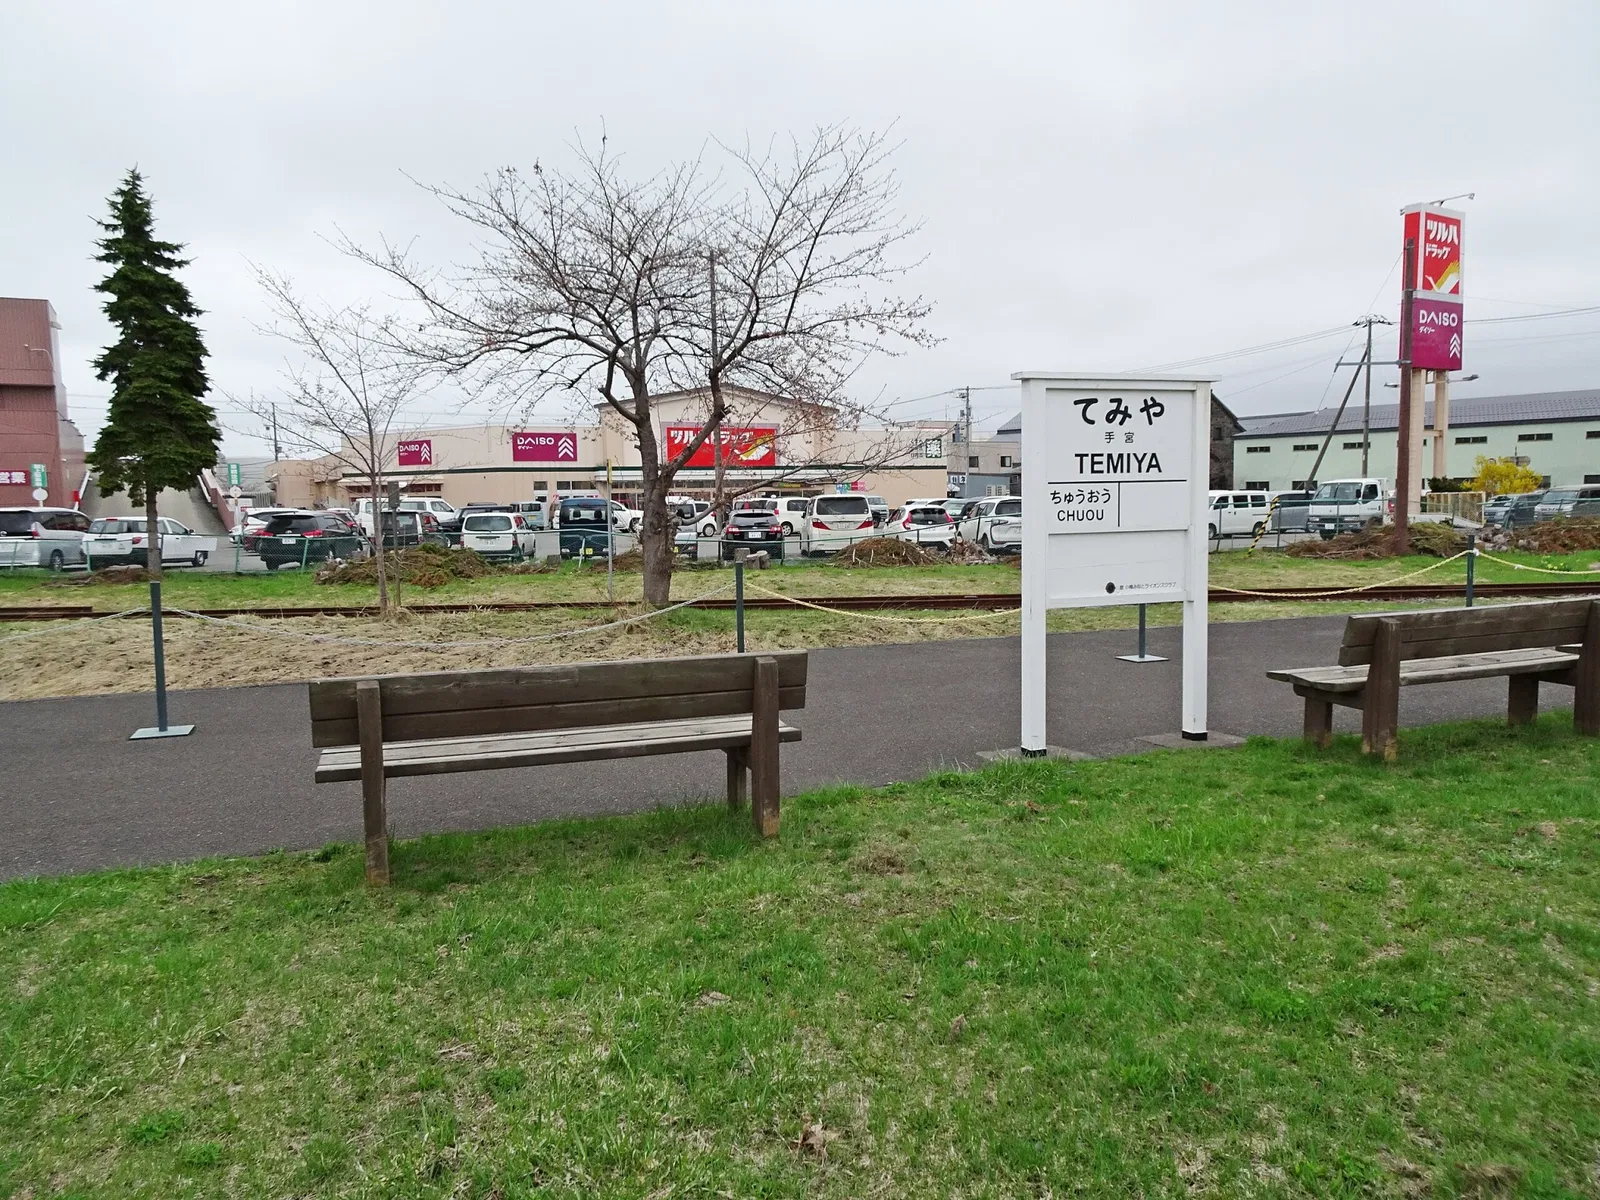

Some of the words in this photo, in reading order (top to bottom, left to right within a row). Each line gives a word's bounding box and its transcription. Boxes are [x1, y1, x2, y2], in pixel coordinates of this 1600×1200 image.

[1426, 220, 1459, 245] ツルハ
[1425, 243, 1451, 260] ドラッグ
[1419, 309, 1458, 327] DAISO
[1419, 326, 1436, 334] ダイソー
[1073, 396, 1165, 426] てみや
[517, 436, 555, 446] DAISO
[1104, 431, 1135, 444] 手宮
[399, 443, 420, 452] DAISO
[926, 439, 941, 458] 薬
[1074, 452, 1163, 474] TEMIYA
[1050, 488, 1112, 505] ちゅうおう
[1057, 509, 1105, 522] CHUOU
